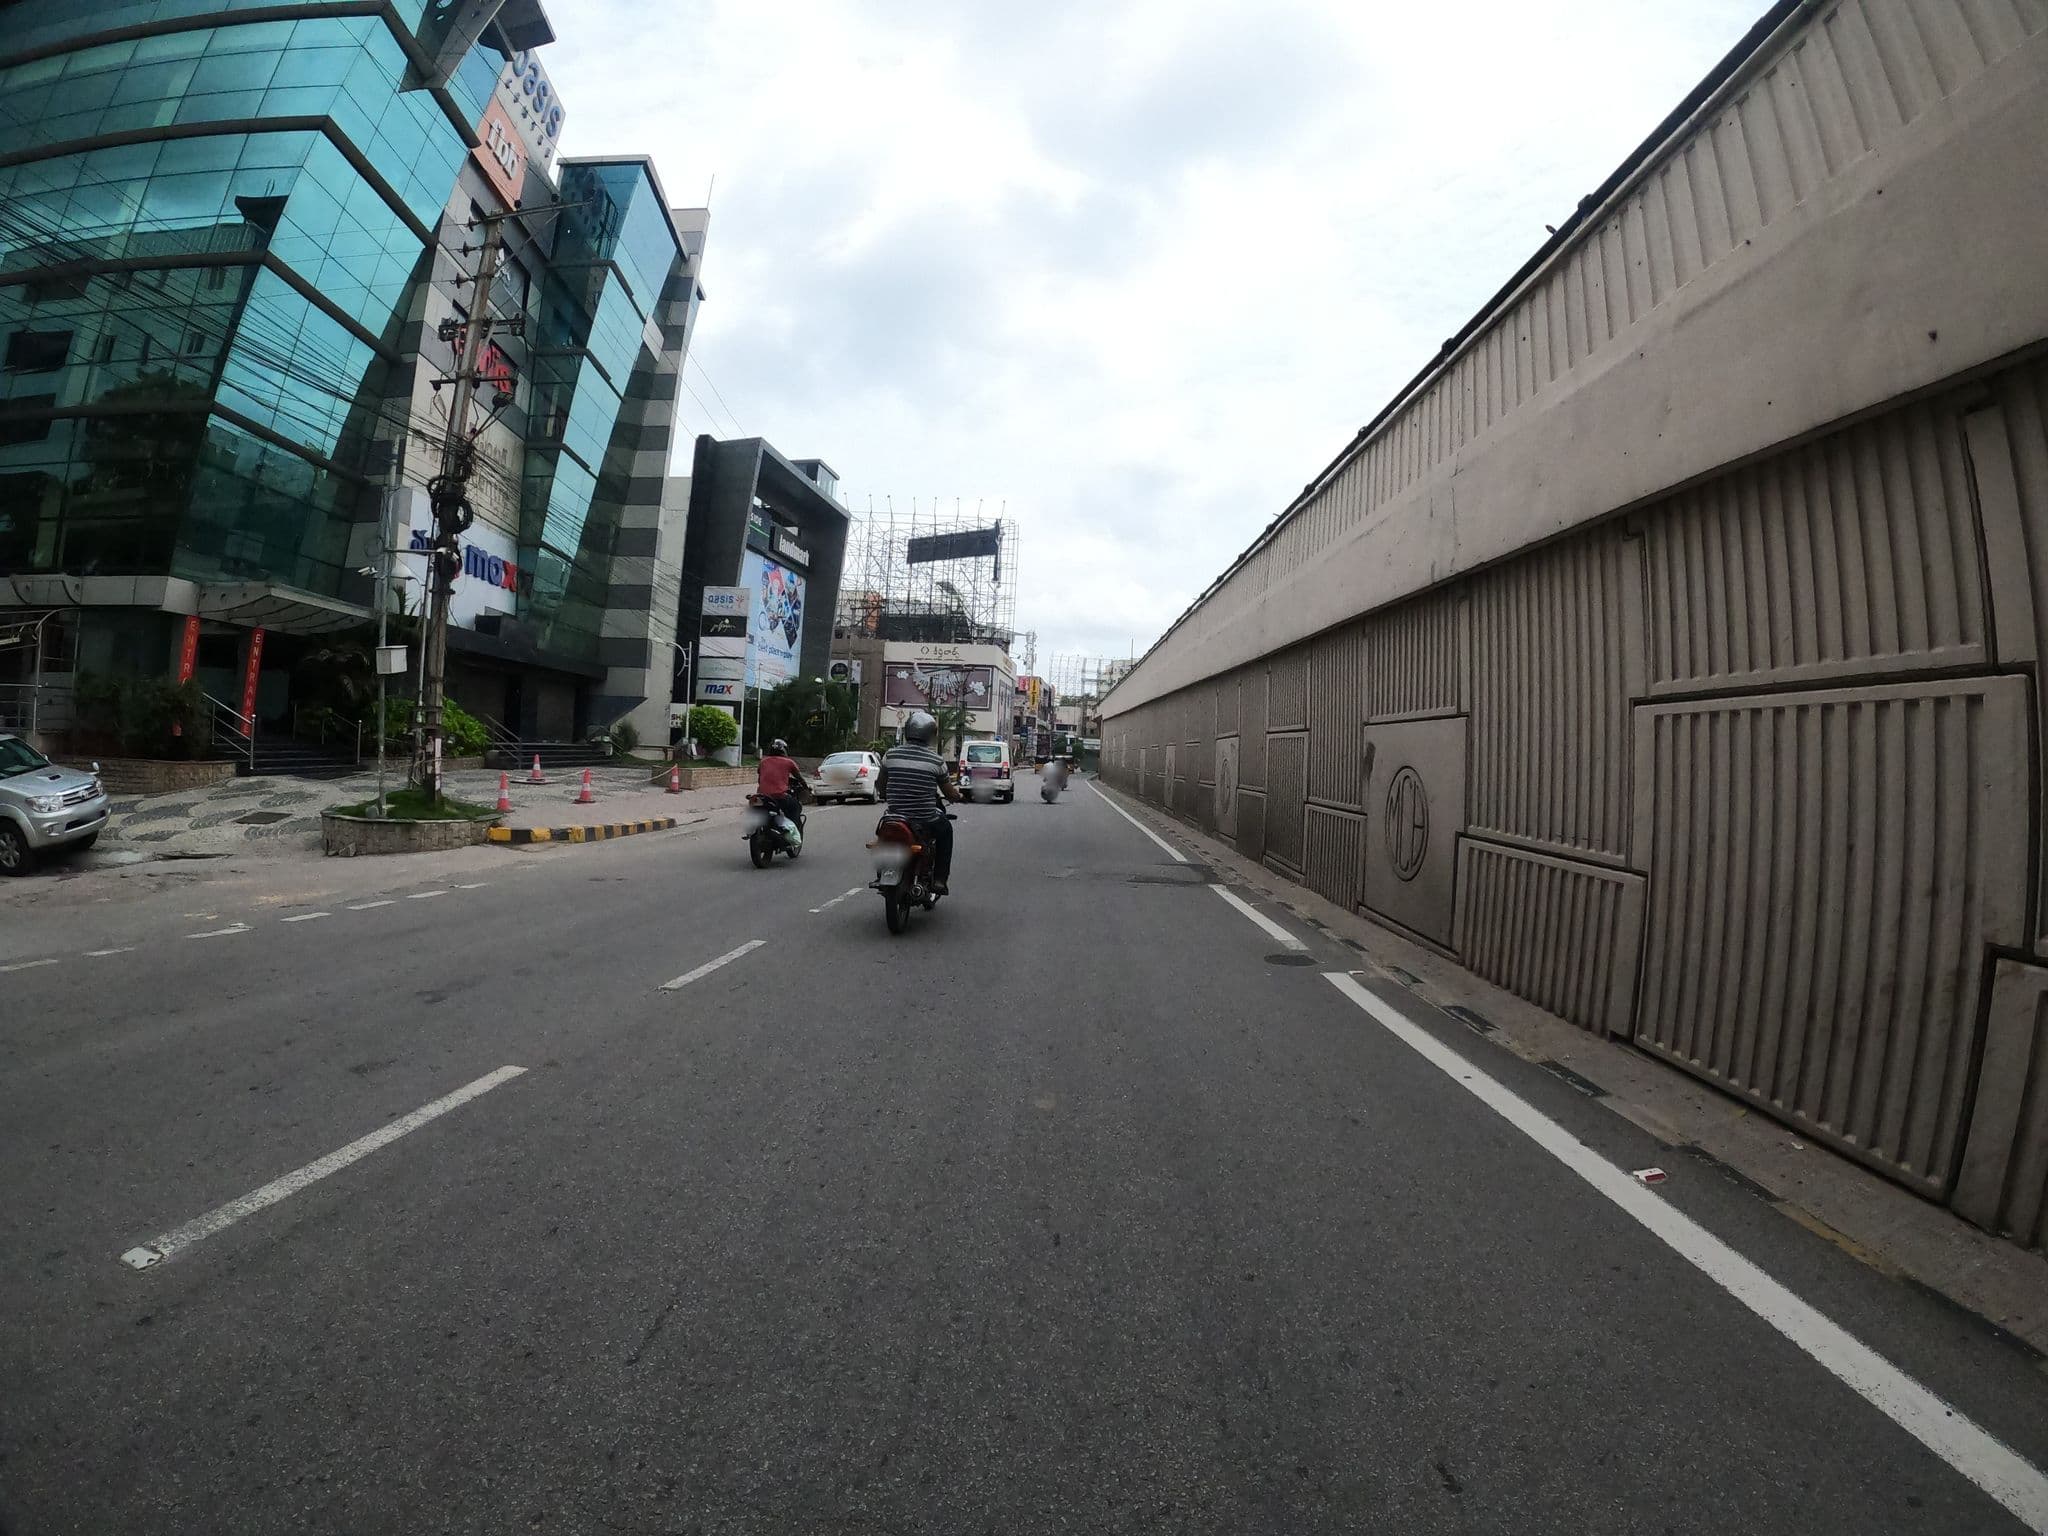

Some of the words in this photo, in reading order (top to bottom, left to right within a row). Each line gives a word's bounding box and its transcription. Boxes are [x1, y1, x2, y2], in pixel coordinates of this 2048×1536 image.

[464, 545, 518, 592] max
[707, 594, 735, 604] oasis
[704, 684, 733, 695] max
